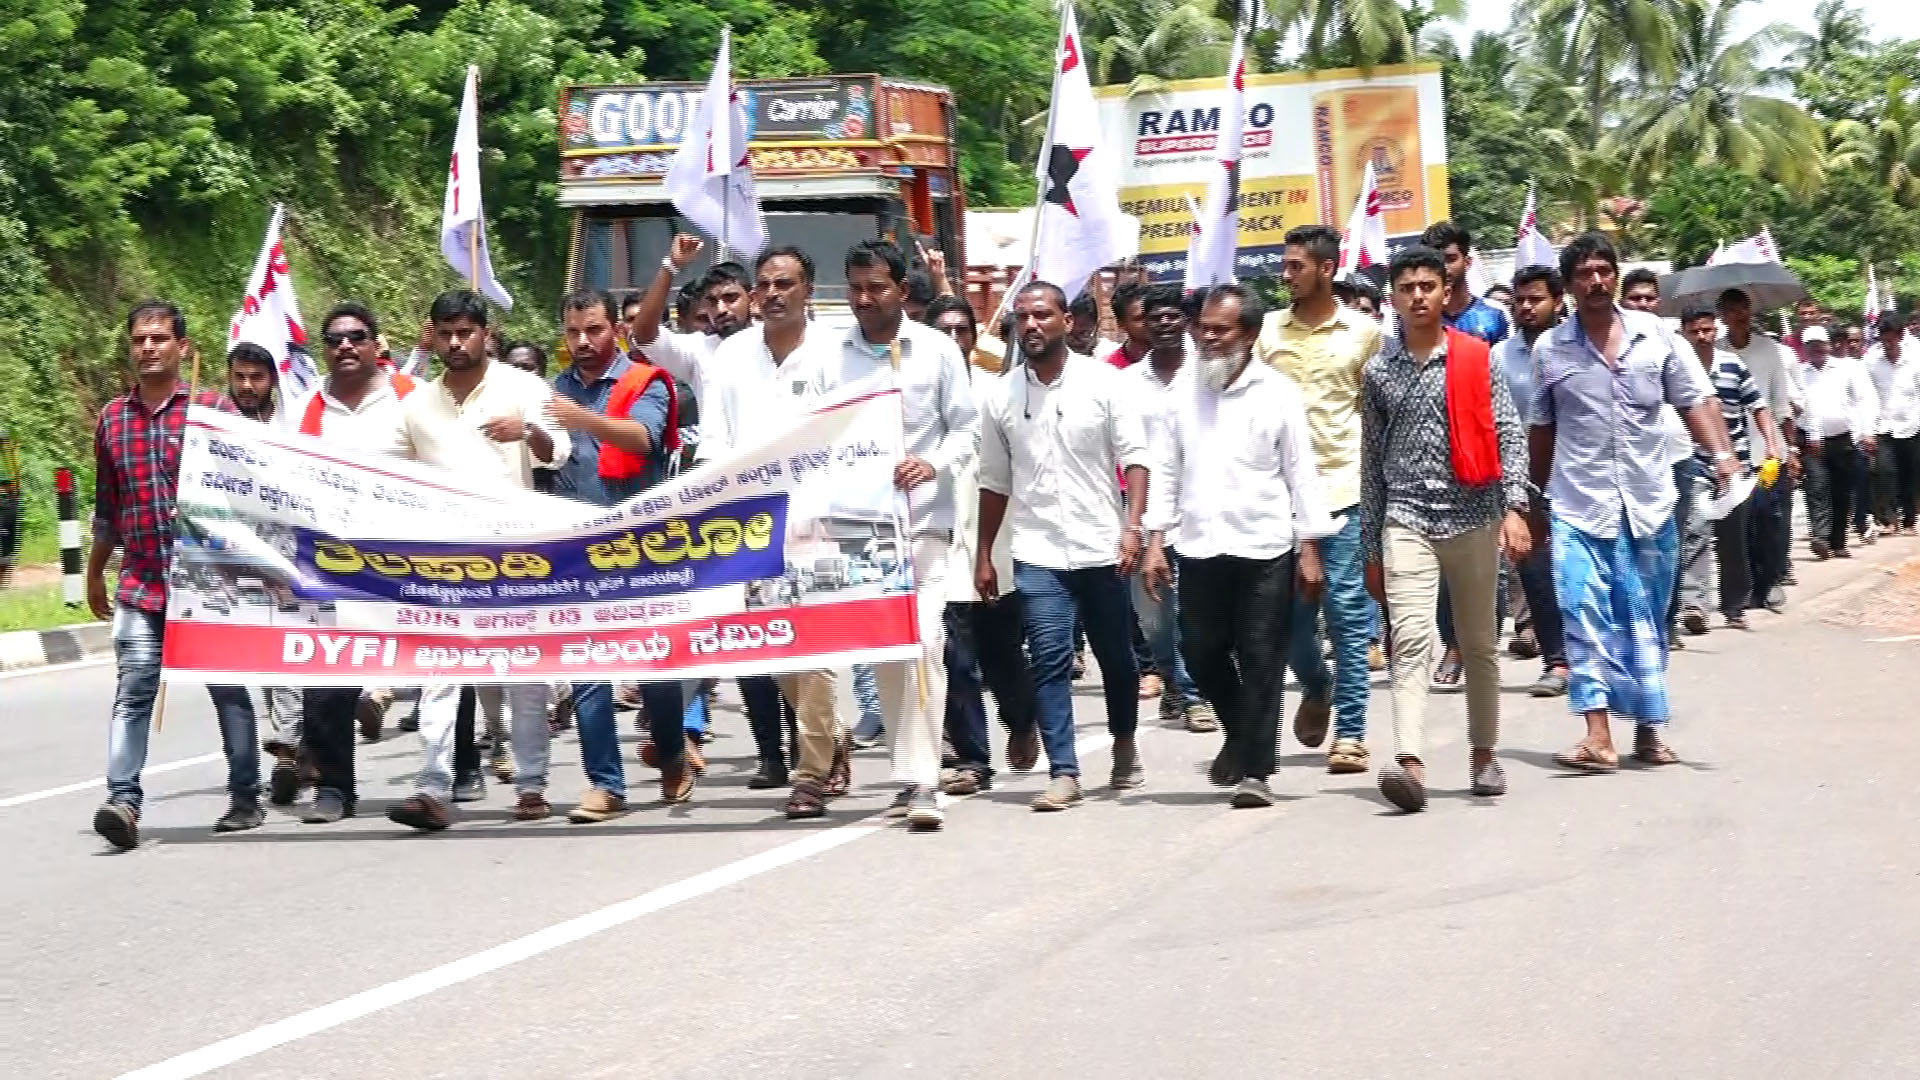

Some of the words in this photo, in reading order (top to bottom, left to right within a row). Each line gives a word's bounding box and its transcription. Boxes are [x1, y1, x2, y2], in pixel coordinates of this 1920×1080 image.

[768, 94, 840, 123] Carrier
[1138, 102, 1275, 136] RAMO
[1138, 133, 1270, 154] SUPERGDE
[1287, 188, 1309, 205] IN
[1140, 220, 1192, 240] PREM
[312, 538, 554, 583] ತಲಪಾಡಿ
[586, 511, 775, 571] ಚಲೋ
[396, 607, 461, 628] 2018
[548, 607, 582, 626] 05
[282, 633, 400, 668] DYFI
[560, 630, 672, 665] ವಲಯ
[689, 618, 798, 656] ಸಮಿತಿ
